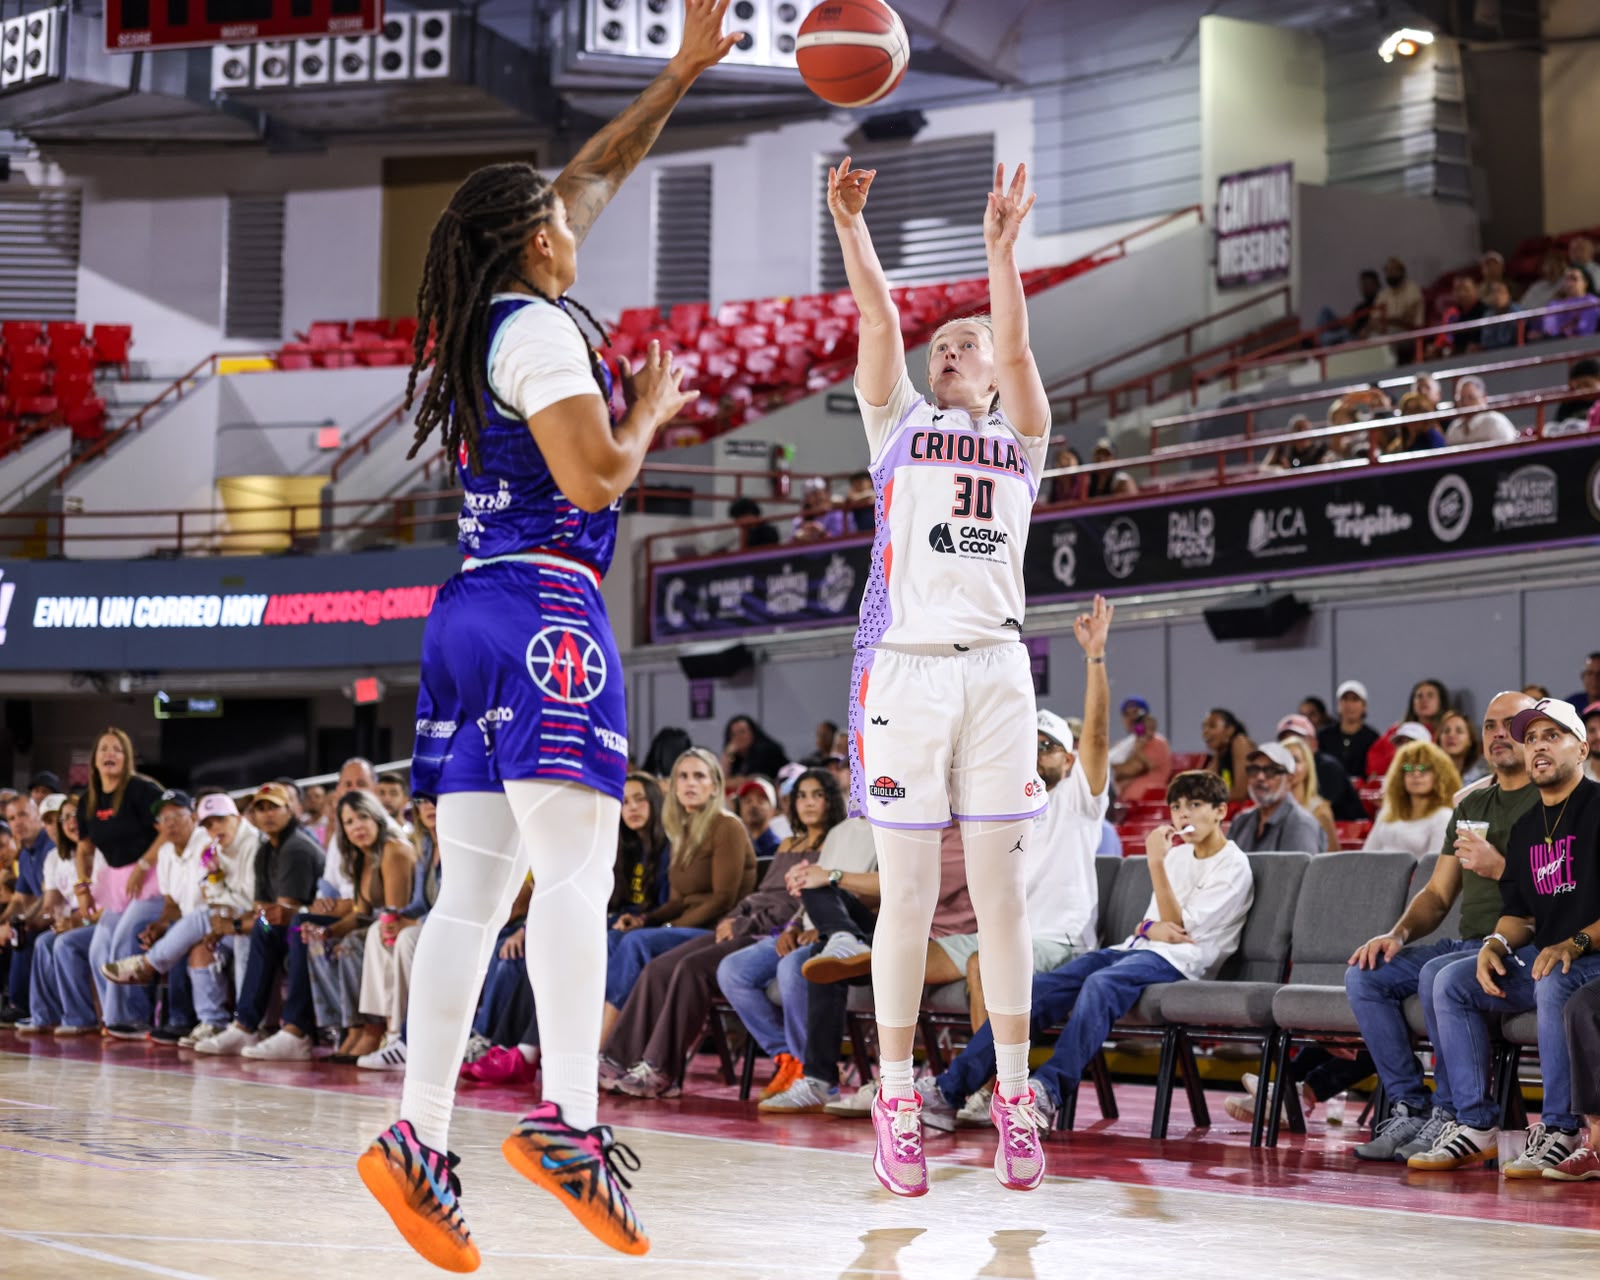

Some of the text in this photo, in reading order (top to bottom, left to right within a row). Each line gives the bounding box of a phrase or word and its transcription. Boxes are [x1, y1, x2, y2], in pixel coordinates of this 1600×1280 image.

[118, 32, 152, 46] SCORE
[952, 474, 996, 522] 30
[959, 540, 997, 556] COOP
[33, 584, 444, 628] ENVIA UN CORREO HOY AUSPICIOS@CRIOLL
[870, 786, 904, 797] CRIOLLAS
